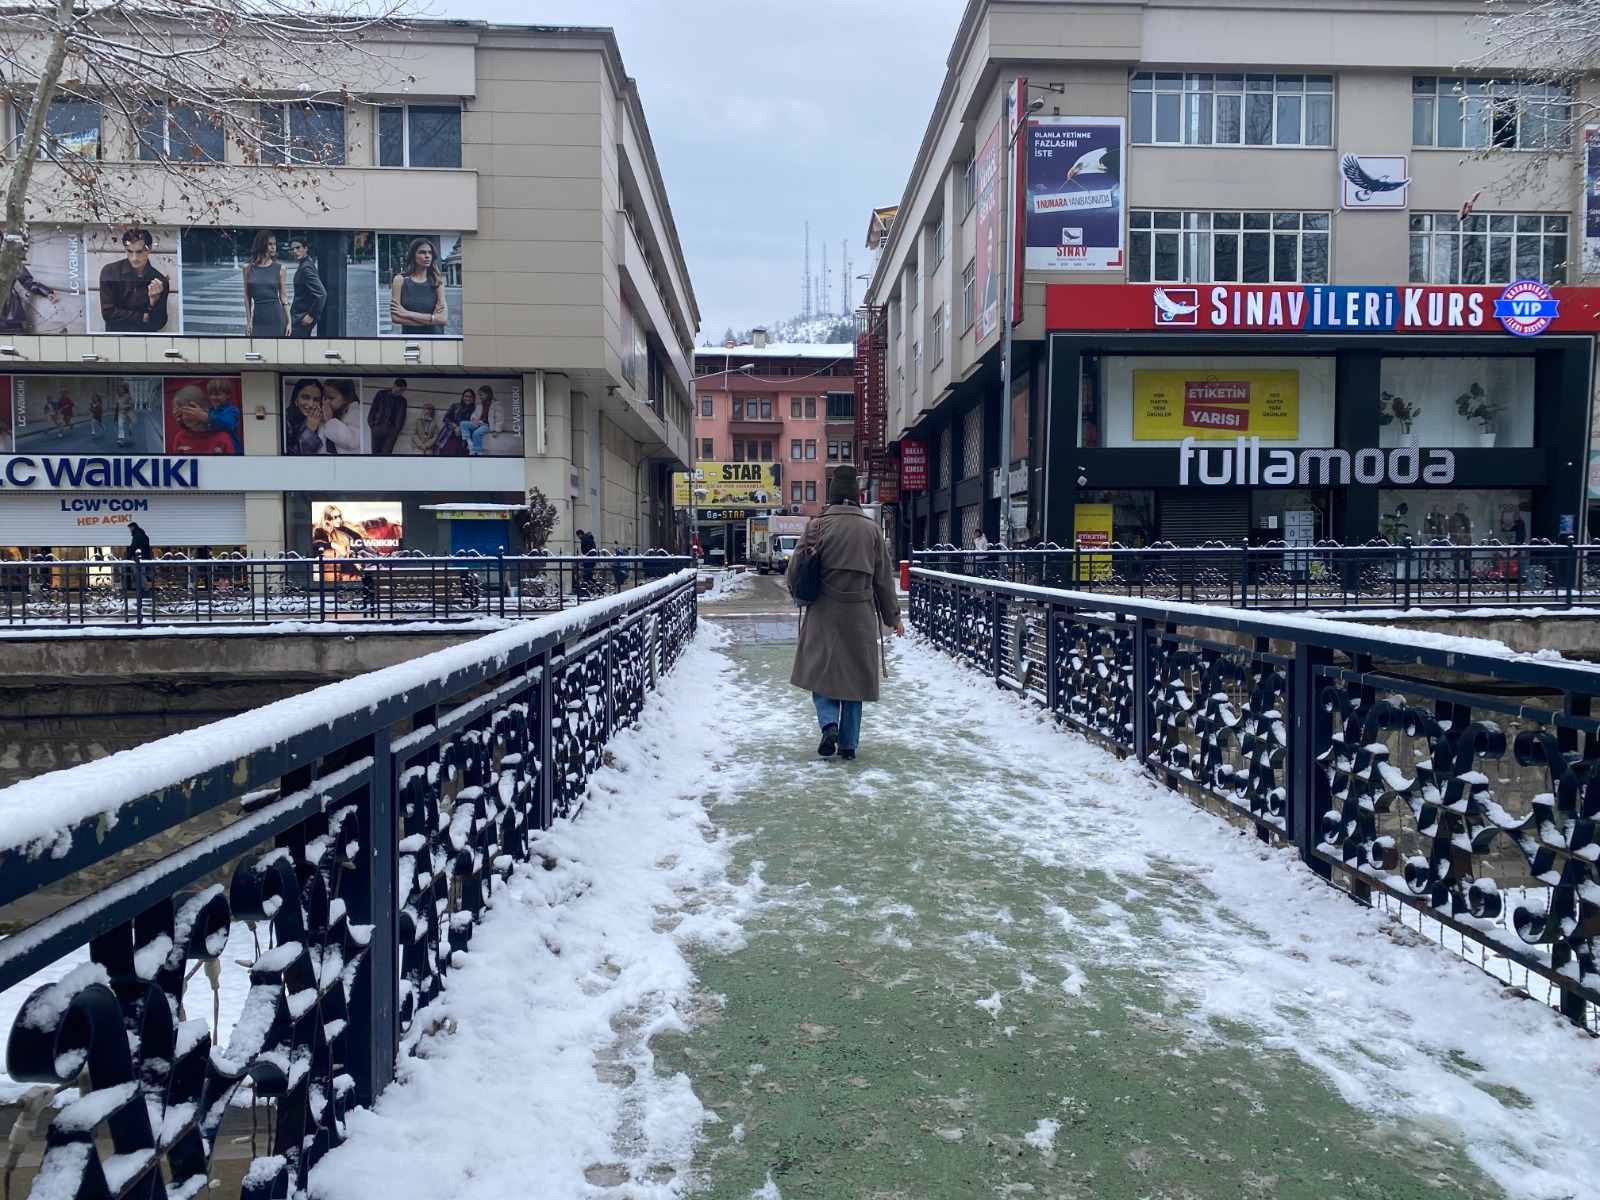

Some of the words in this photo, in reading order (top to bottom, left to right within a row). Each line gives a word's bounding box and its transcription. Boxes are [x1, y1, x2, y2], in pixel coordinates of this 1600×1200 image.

[1035, 148, 1053, 157] İSTE
[1056, 244, 1087, 256] SINAV
[70, 281, 80, 296] LC
[1211, 286, 1304, 326] SINAV
[1404, 288, 1484, 327] KURS
[1512, 302, 1542, 315] VIP
[1189, 385, 1246, 398] ETİKETİN
[18, 415, 26, 427] LC
[1191, 411, 1240, 426] YARISI
[512, 425, 521, 437] LC
[1179, 435, 1455, 485] fullamoda
[0, 457, 37, 487] C
[722, 465, 761, 480] STAR
[77, 517, 99, 526] HEP
[102, 514, 133, 526] AÇIK!
[350, 539, 363, 547] LC
